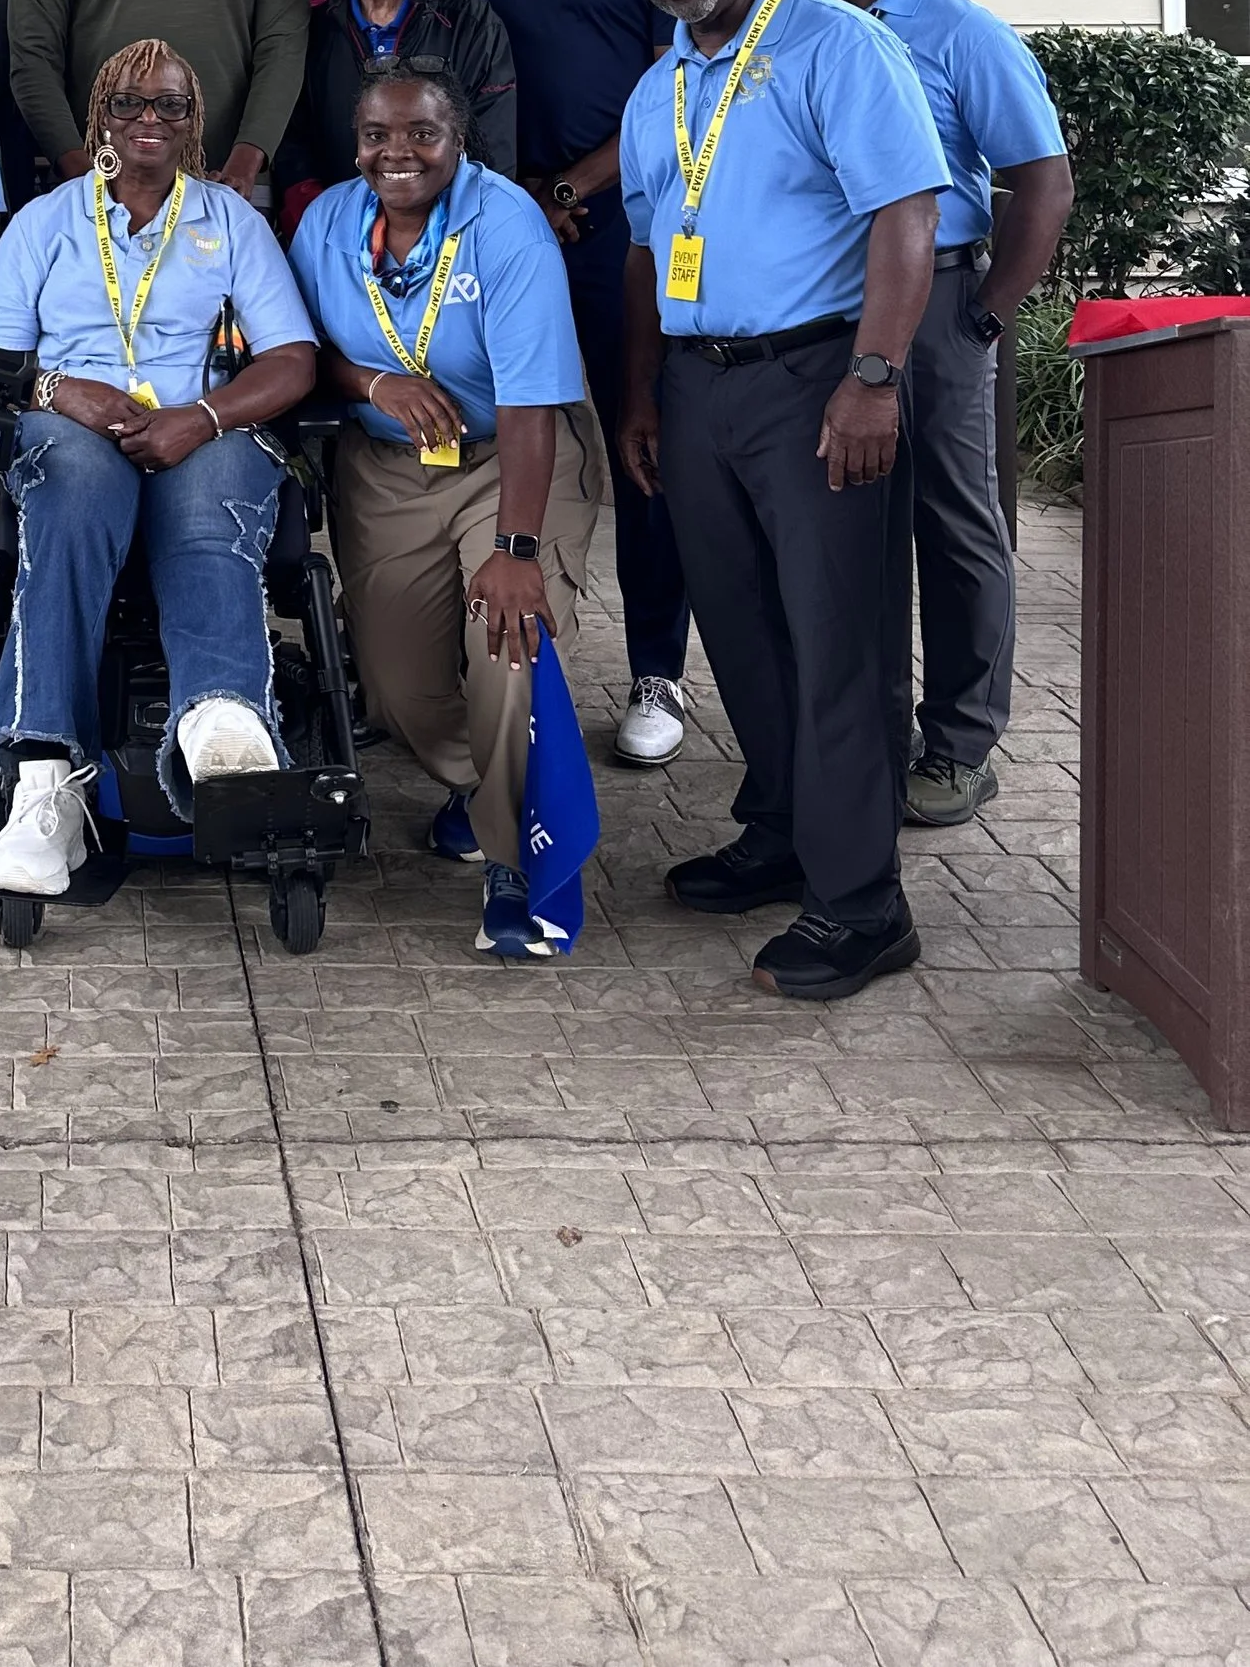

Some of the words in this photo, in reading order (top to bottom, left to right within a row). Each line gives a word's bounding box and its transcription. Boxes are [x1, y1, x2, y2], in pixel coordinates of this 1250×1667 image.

[745, 23, 764, 49] EVENT
[716, 89, 731, 118] EVENT
[729, 62, 742, 88] STAFF
[679, 141, 693, 168] EVENT
[692, 161, 706, 192] EVENT
[701, 132, 717, 161] STAFF
[96, 205, 105, 226] STAFF
[167, 207, 178, 229] EVENT
[173, 187, 182, 208] STAFF
[100, 237, 112, 261] EVENT
[673, 250, 699, 265] EVENT
[104, 262, 116, 285] STAFF
[438, 256, 451, 284] EVENT
[671, 266, 696, 283] STAFF
[370, 289, 384, 316] EVENT
[430, 286, 442, 313] STAFF
[386, 329, 404, 354] STAFF
[418, 326, 430, 354] EVENT
